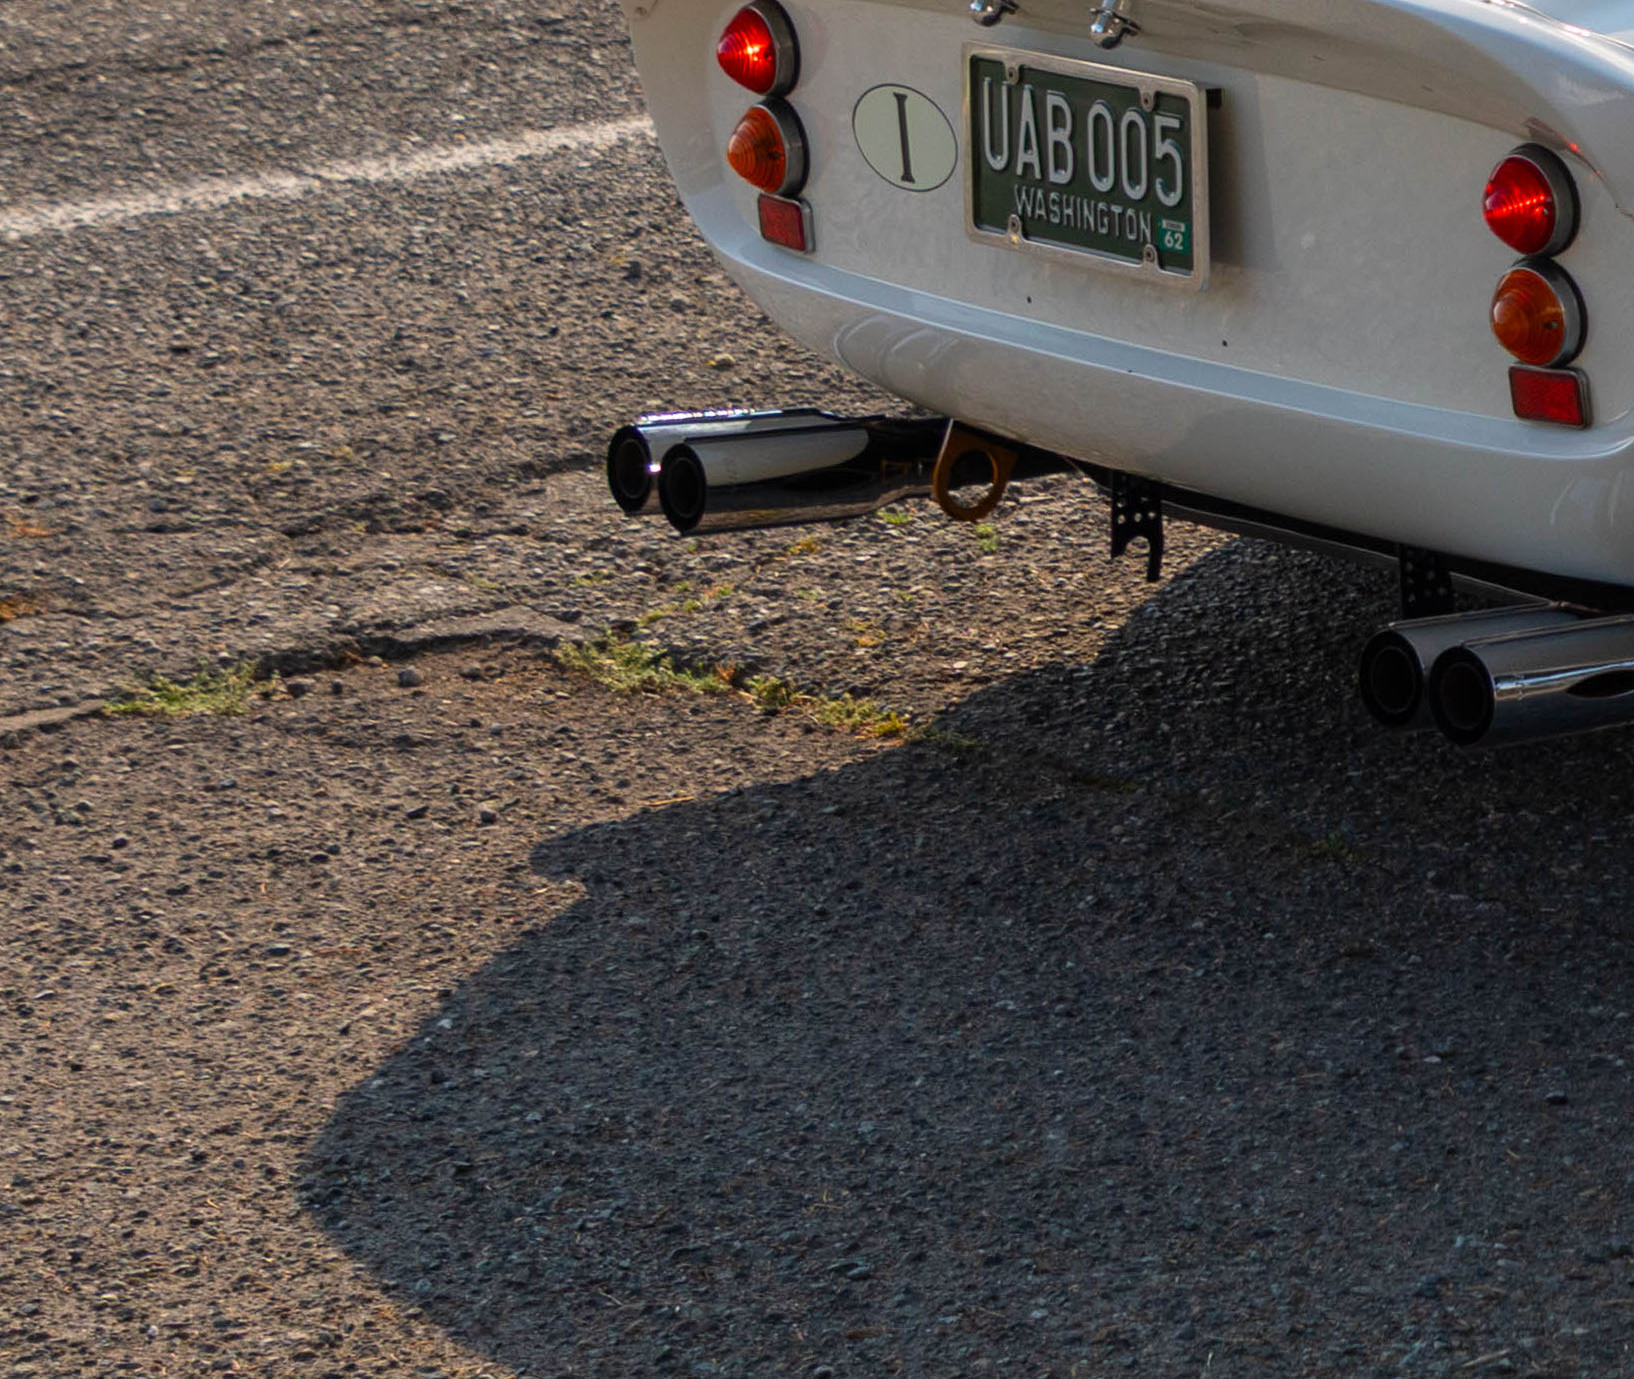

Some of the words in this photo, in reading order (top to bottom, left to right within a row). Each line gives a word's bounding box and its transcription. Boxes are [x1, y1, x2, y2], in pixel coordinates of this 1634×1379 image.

[982, 76, 1074, 185] UAB
[1087, 99, 1184, 207] 005
[1014, 183, 1152, 244] WASHINGTON
[1164, 231, 1184, 251] 62
